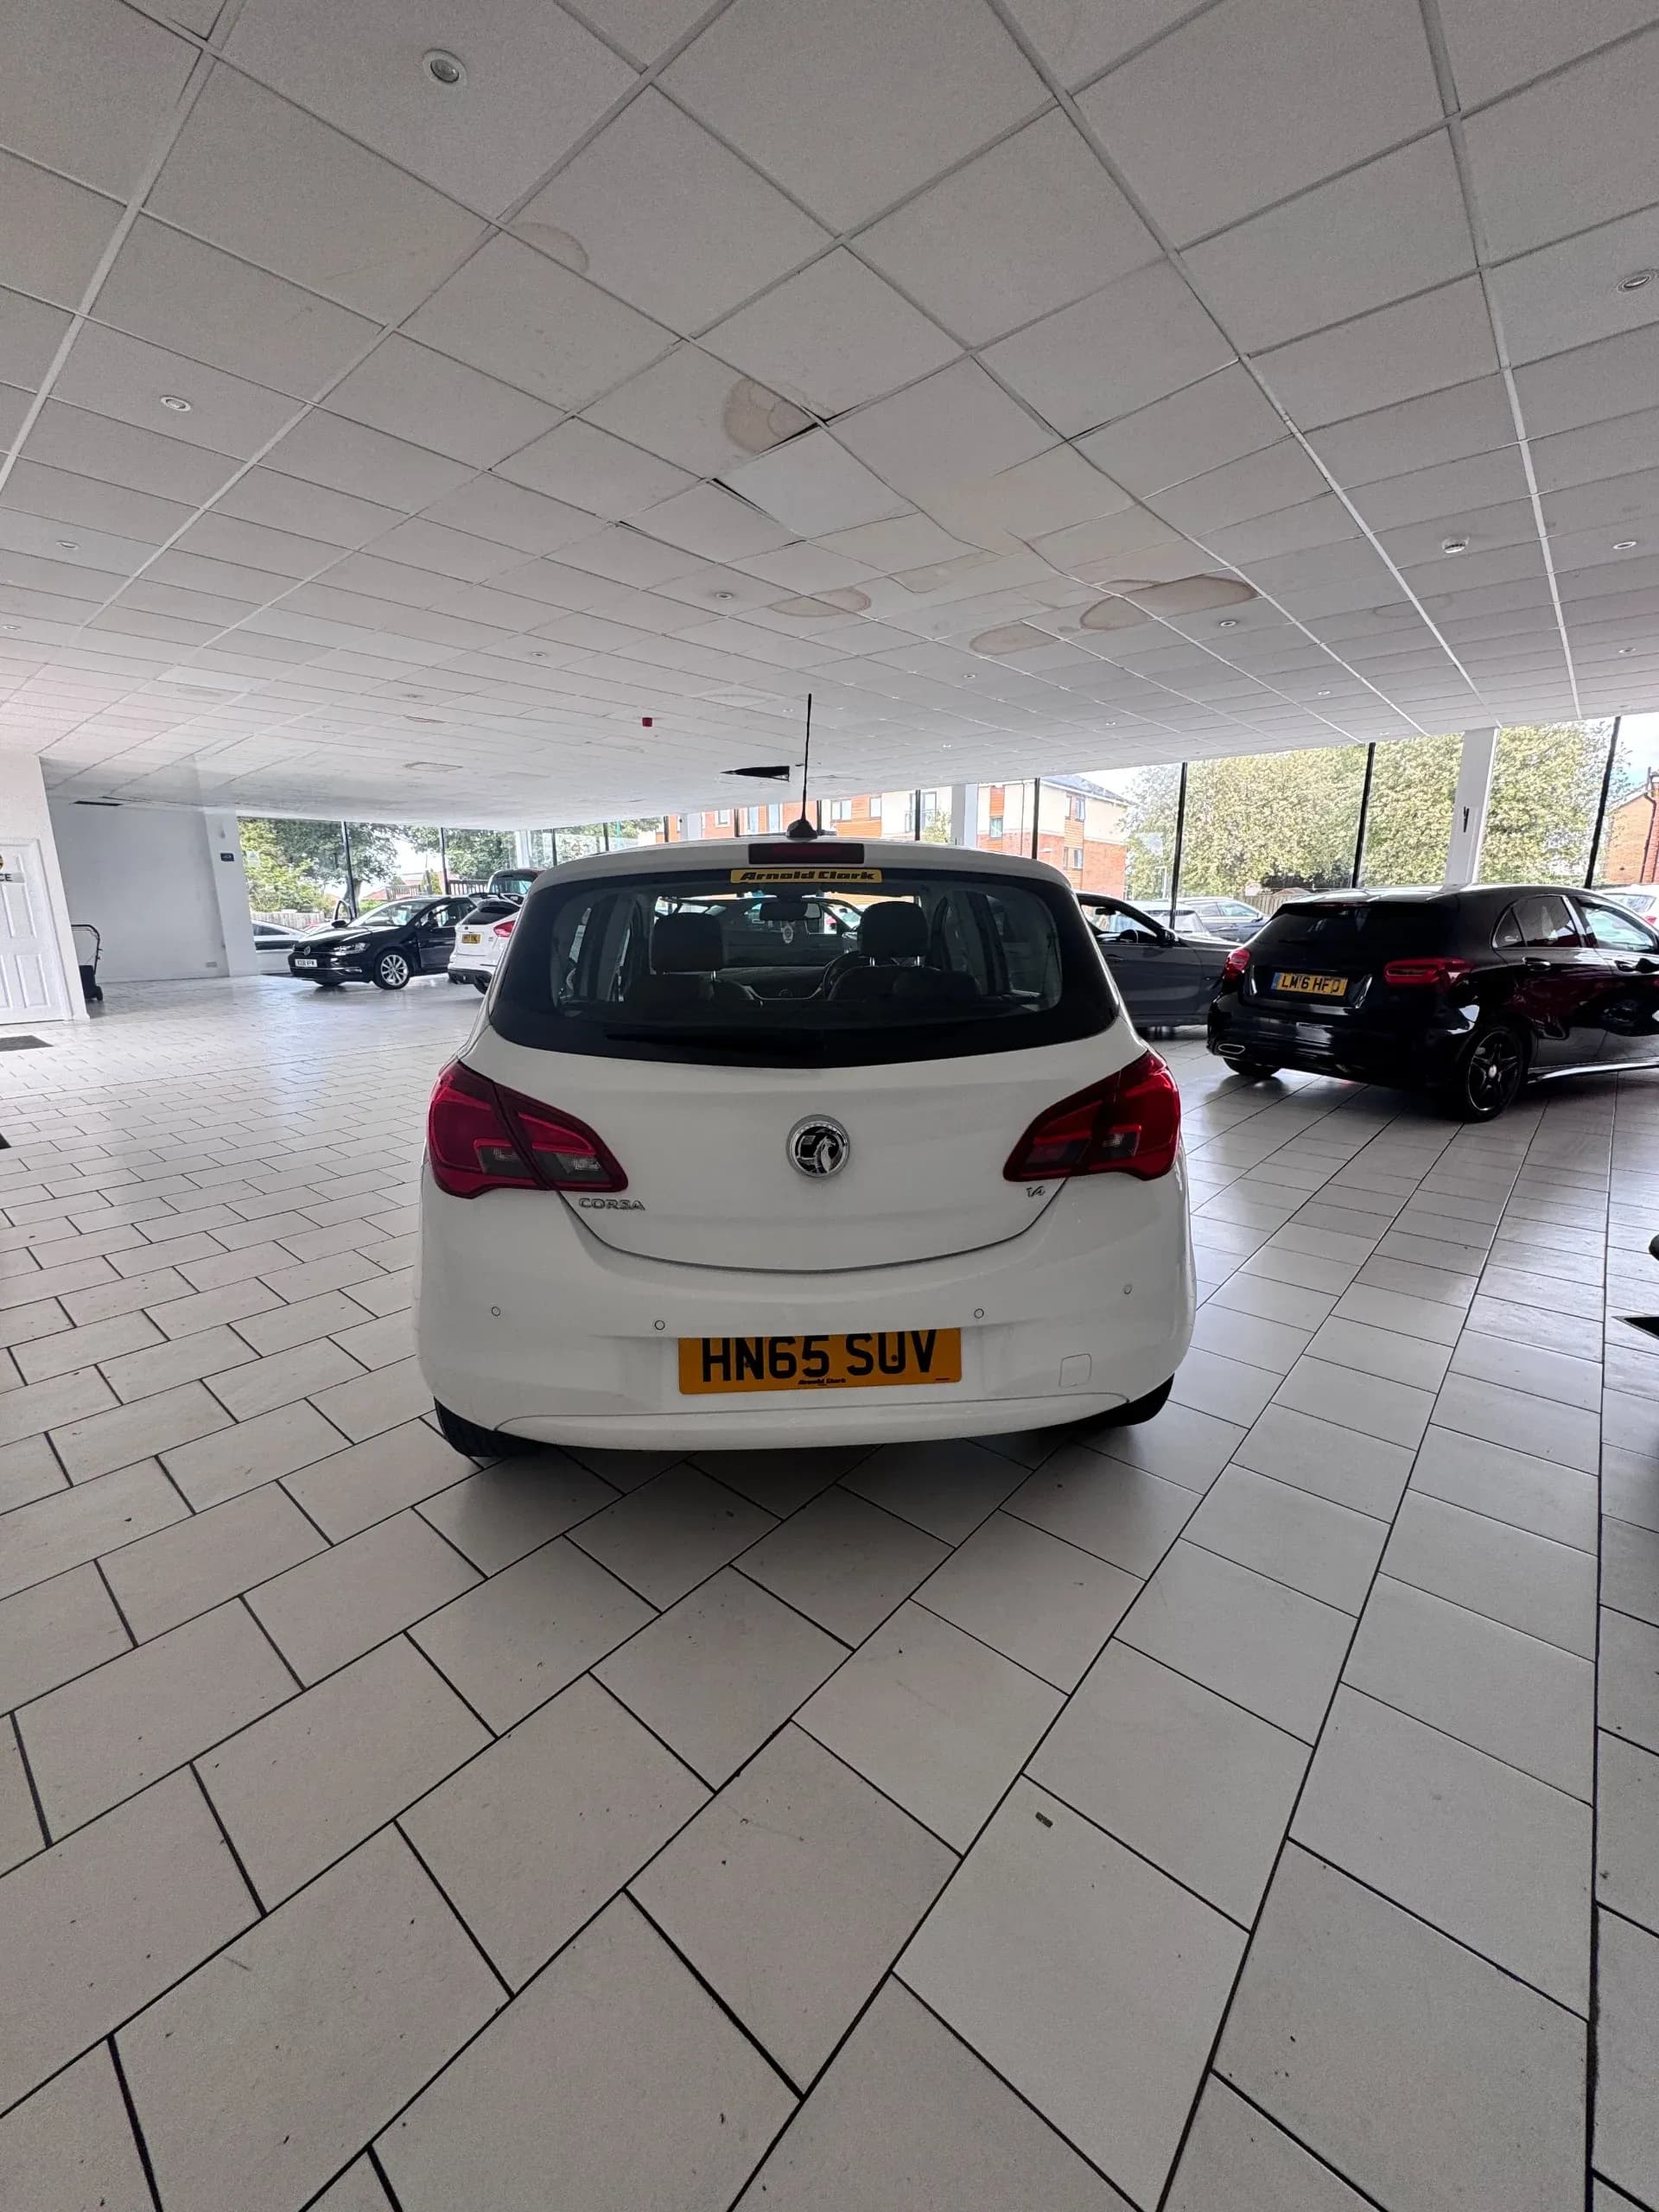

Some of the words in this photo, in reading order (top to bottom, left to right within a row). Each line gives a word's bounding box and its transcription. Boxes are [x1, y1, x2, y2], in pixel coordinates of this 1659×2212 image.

[740, 871, 815, 880] Arnold
[818, 871, 875, 880] Clark
[578, 1198, 646, 1211] CORSA
[702, 1335, 830, 1382] HN65
[845, 1329, 937, 1376] SUV
